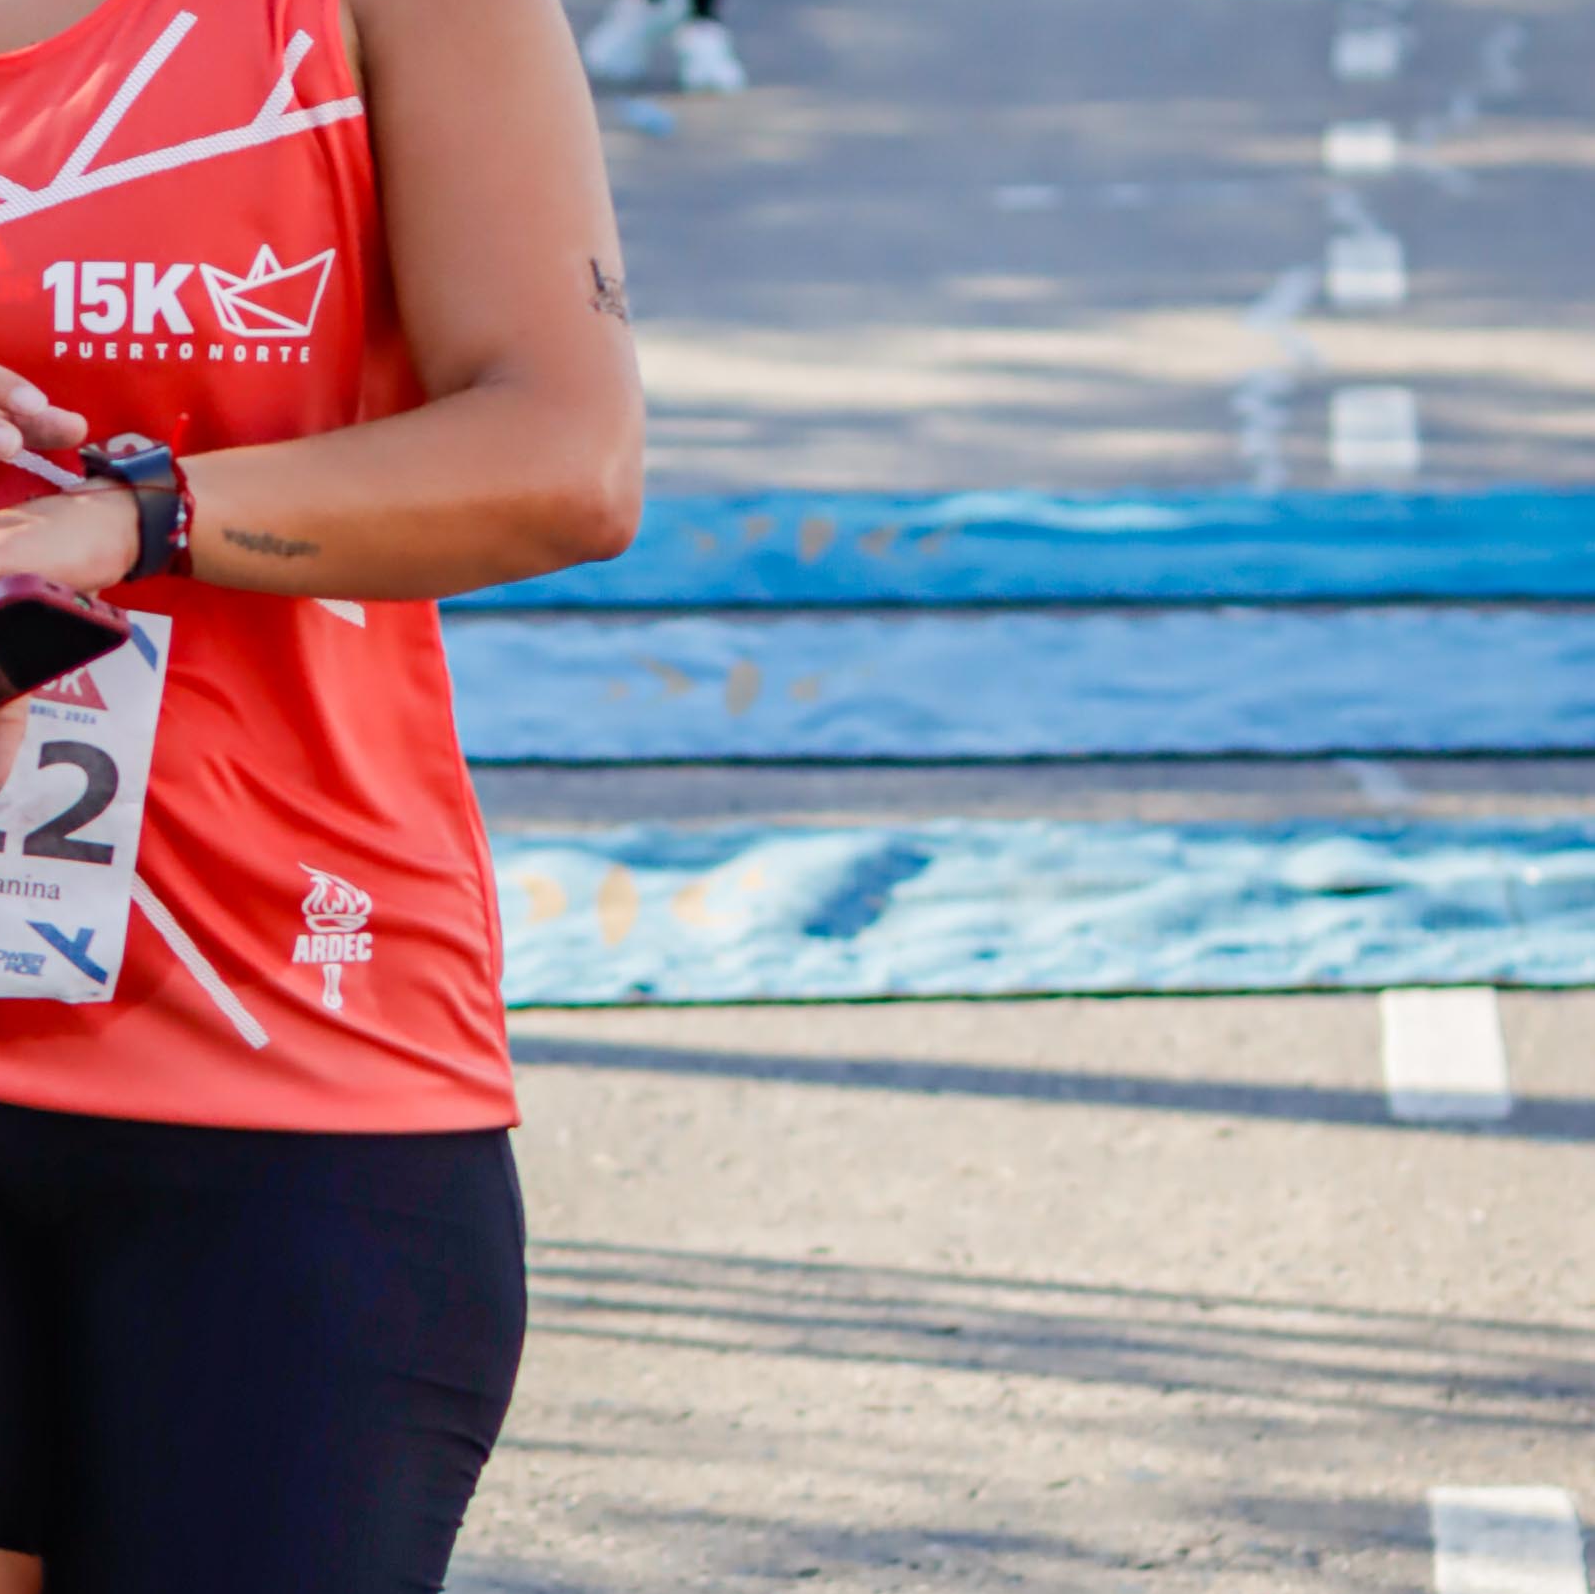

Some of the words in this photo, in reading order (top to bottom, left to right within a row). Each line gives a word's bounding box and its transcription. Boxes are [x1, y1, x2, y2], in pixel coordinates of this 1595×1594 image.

[42, 261, 195, 335] 15K
[54, 341, 194, 360] PUERTO
[208, 343, 311, 363] NORTE
[292, 931, 374, 964] ARDEC
